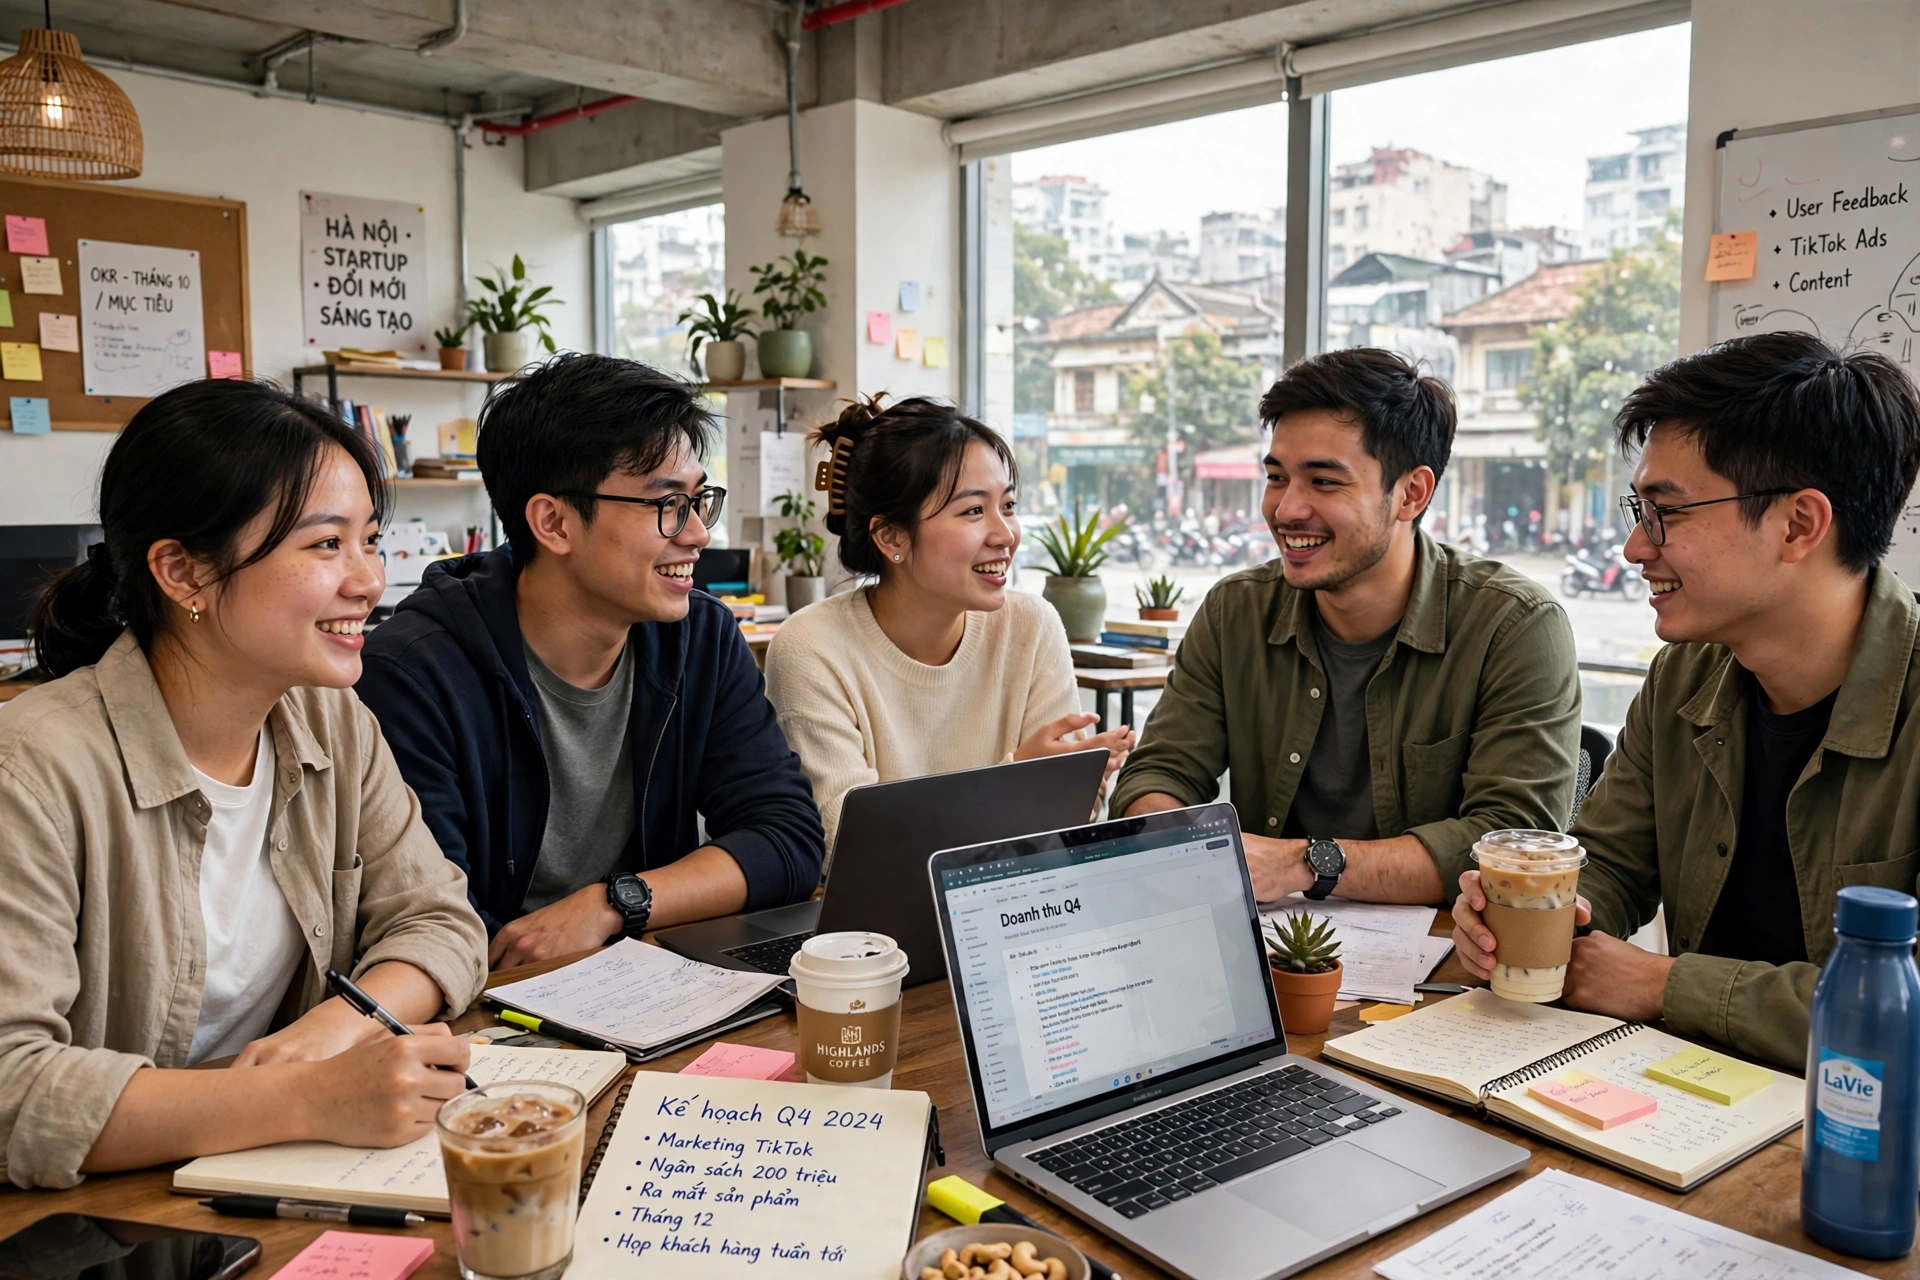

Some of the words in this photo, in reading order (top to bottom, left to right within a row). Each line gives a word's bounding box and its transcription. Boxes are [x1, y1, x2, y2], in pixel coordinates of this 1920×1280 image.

[1786, 196, 1823, 219] User
[1832, 182, 1909, 213] Feedback
[325, 213, 355, 240] HÀ
[363, 218, 398, 248] NỘI
[1790, 232, 1847, 256] TikTok
[1855, 226, 1888, 250] Ads
[323, 246, 409, 272] STARTUP
[90, 266, 118, 284] OKR
[132, 267, 173, 289] THÁNG
[177, 275, 191, 290] 10
[327, 268, 363, 297] ĐỔI
[370, 275, 406, 300] MỚI
[1789, 267, 1853, 293] Content
[108, 294, 138, 315] MỤC
[143, 292, 174, 314] TIÊU
[320, 301, 372, 328] SÁNG
[377, 309, 413, 334] TẠO
[1000, 906, 1041, 928] Doanh
[1041, 902, 1063, 919] thu
[1063, 897, 1082, 914] Q4
[816, 1040, 886, 1058] HIGHLANDS
[828, 1057, 871, 1069] COFFEE
[1824, 1068, 1874, 1097] LaVie
[656, 1093, 700, 1117] Kế
[777, 1105, 812, 1127] Q4
[823, 1109, 884, 1131] 2024
[657, 1131, 746, 1159] Marketing
[755, 1138, 814, 1157] TikTok
[649, 1157, 696, 1179] Ngân
[704, 1161, 743, 1178] sách
[752, 1165, 788, 1181] 200
[795, 1167, 838, 1188] triệu
[639, 1181, 663, 1199] Ra
[672, 1181, 708, 1200] mắt
[714, 1186, 745, 1203] sản
[750, 1188, 800, 1211] phẩm
[631, 1206, 684, 1232] Tháng
[693, 1212, 714, 1228] 12
[616, 1232, 652, 1257] Họp
[660, 1234, 711, 1254] khách
[720, 1238, 762, 1265] hàng
[770, 1241, 811, 1260] tuần
